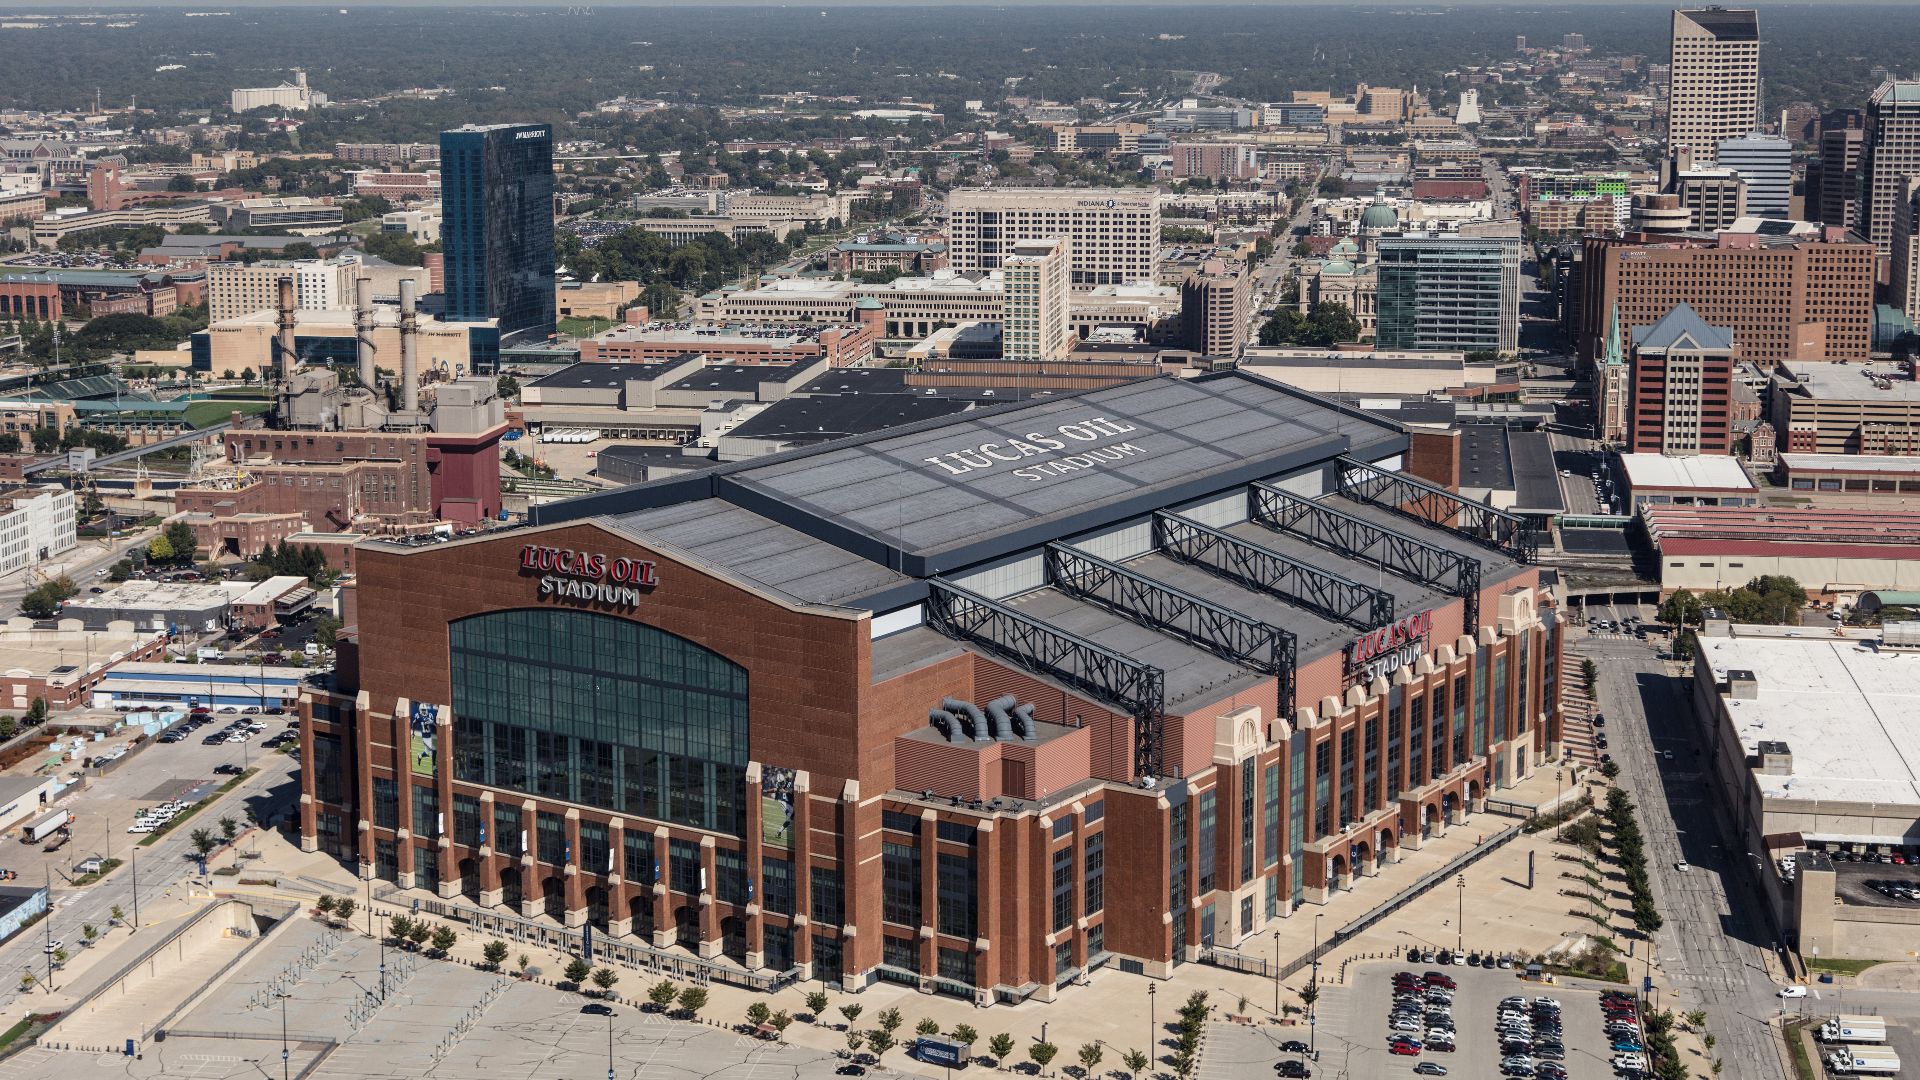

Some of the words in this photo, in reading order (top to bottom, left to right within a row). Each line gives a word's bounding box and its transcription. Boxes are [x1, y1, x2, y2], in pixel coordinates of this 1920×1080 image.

[924, 432, 1066, 475] LUCAS
[1057, 417, 1137, 441] OIL
[1012, 442, 1148, 481] STADIUM
[521, 544, 607, 578] LUCAS
[610, 557, 660, 586] OIL
[541, 575, 640, 607] STADIUM
[1353, 618, 1408, 662] LUCAS
[1408, 608, 1434, 640] OIL
[1367, 642, 1422, 682] STADIUM
